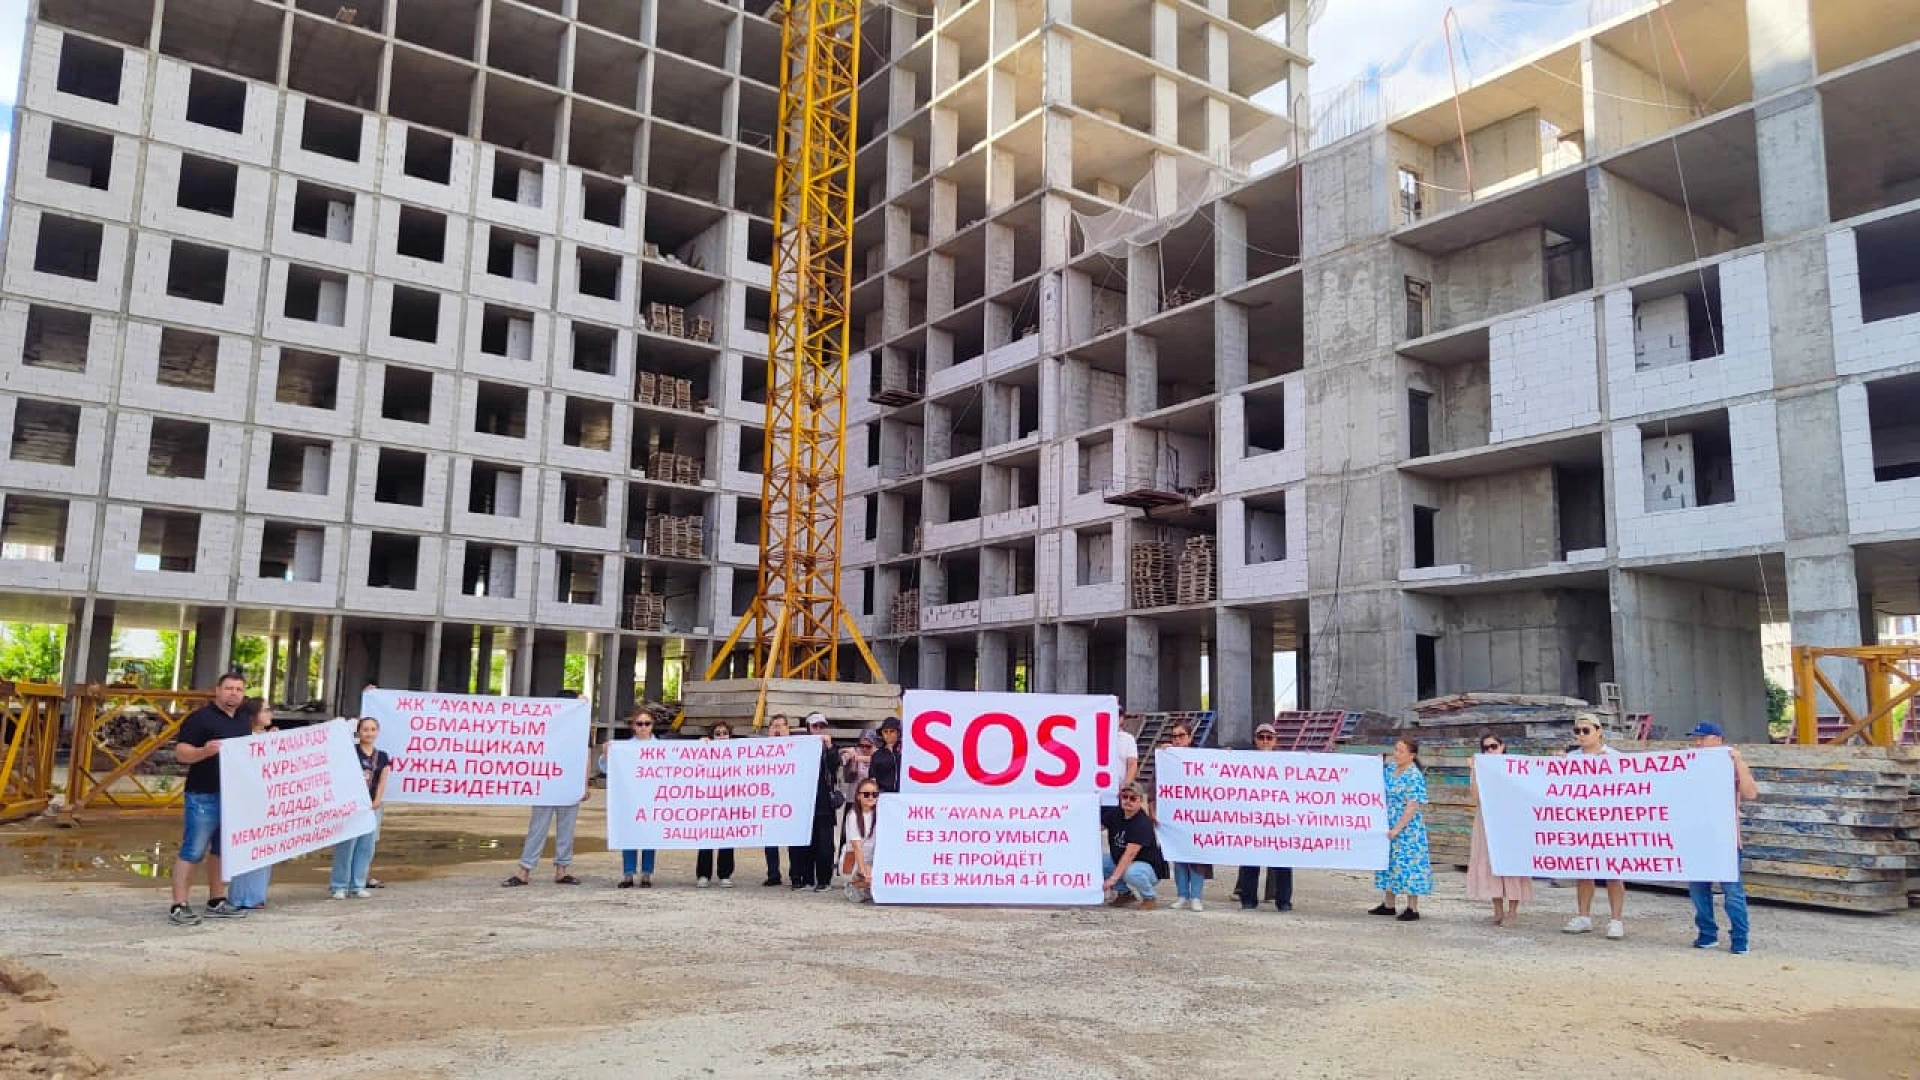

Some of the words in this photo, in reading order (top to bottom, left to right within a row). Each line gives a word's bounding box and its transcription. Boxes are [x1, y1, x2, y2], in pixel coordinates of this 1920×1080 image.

[396, 697, 424, 711] ЖК
[410, 716, 546, 735] ОБМАНУТЫМ
[406, 736, 545, 756] ДОЛЬЩИКАМ
[639, 747, 666, 760] ЖК
[907, 710, 1112, 789] SOS!
[464, 760, 563, 780] ПОМОЩЬ
[635, 765, 742, 780] ЗАСТРОЙЩИК
[747, 763, 796, 777] КИНУЛ
[1182, 761, 1205, 777] ТК
[1505, 757, 1529, 775] ТК
[402, 777, 540, 797] ПРЕЗИДЕНТА!
[654, 782, 775, 802] ДОЛЬЩИКОВ,
[1546, 780, 1651, 799] АЛДАНҒАН
[1158, 785, 1290, 803] ЖЕМҚОРЛАРҒА
[1295, 791, 1336, 805] ЖОЛ
[1340, 792, 1383, 809] ЖОҚ
[635, 808, 647, 821] А
[653, 806, 756, 822] ГОСОРГАНЫ
[762, 803, 793, 819] ЕГО
[907, 806, 936, 820] ЖК
[1533, 806, 1669, 822] ҮЛЕСКЕРЛЕРГЕ
[662, 824, 763, 841] ЗАЩИЩАЮТ!
[906, 830, 933, 842] БЕЗ
[939, 830, 991, 843] ЗЛОГО
[995, 829, 1069, 844] УМЫСЛА
[1193, 830, 1351, 852] ҚАЙТАРЫҢЫЗДАР!!!
[1535, 831, 1674, 850] ПРЕЗИДЕНТТІҢ
[933, 852, 954, 865] НЕ
[958, 849, 1043, 868] ПРОЙДЁТ!
[1533, 856, 1600, 871] КӨМЕГІ
[1607, 857, 1683, 875] ҚАЖЕТ!
[884, 872, 915, 886] МЫ
[920, 872, 949, 886] БЕЗ
[953, 872, 1015, 887] ЖИЛЬЯ
[1019, 870, 1047, 887] 4-Й
[1053, 872, 1092, 888] ГОД!
